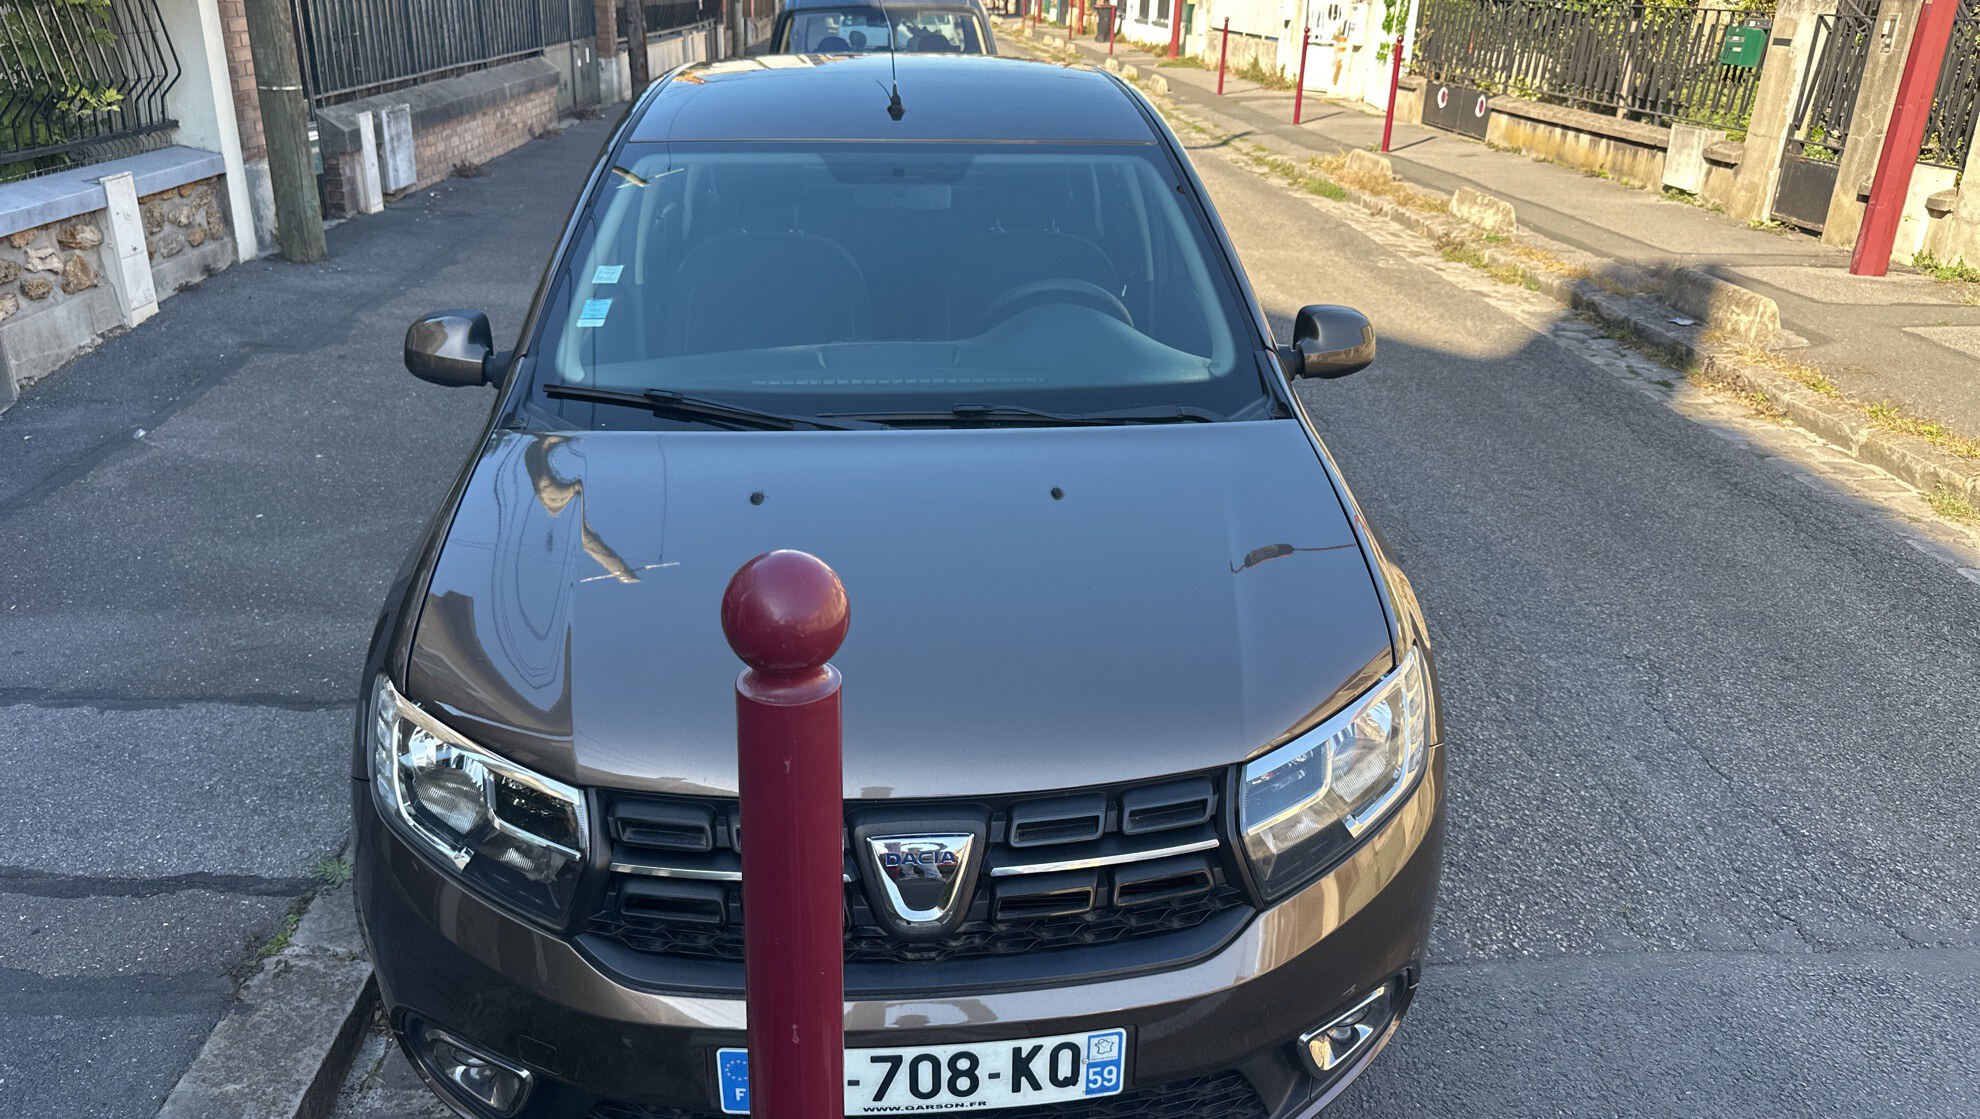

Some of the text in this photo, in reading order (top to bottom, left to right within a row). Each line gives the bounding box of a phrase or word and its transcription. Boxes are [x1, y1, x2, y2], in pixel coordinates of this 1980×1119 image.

[885, 851, 958, 867] DACIA
[1088, 1065, 1118, 1089] 59
[735, 1088, 747, 1101] F
